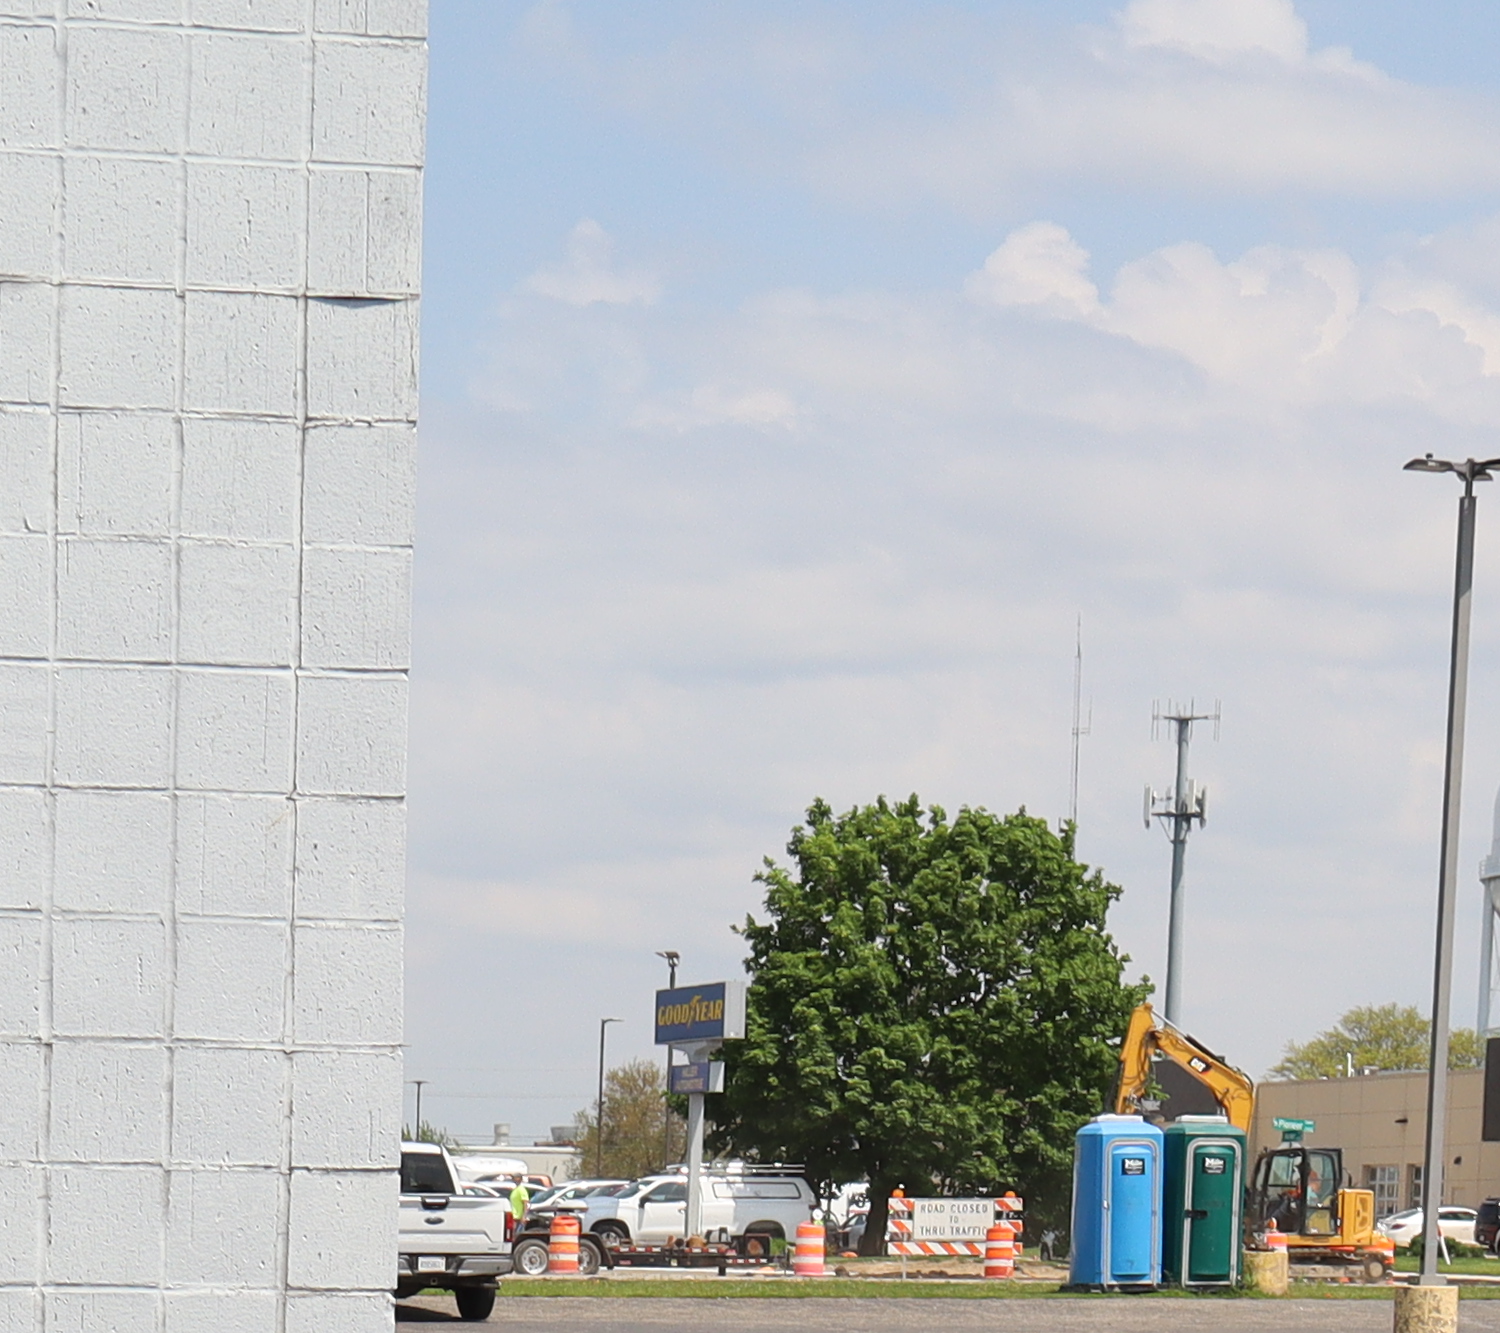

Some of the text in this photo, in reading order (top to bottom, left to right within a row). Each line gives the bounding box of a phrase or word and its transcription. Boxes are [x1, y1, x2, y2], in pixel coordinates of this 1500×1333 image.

[657, 996, 723, 1027] GOODYEAR
[920, 1204, 988, 1213] ROAD CLOSED
[950, 1215, 959, 1223] TO
[920, 1226, 945, 1235] THRU
